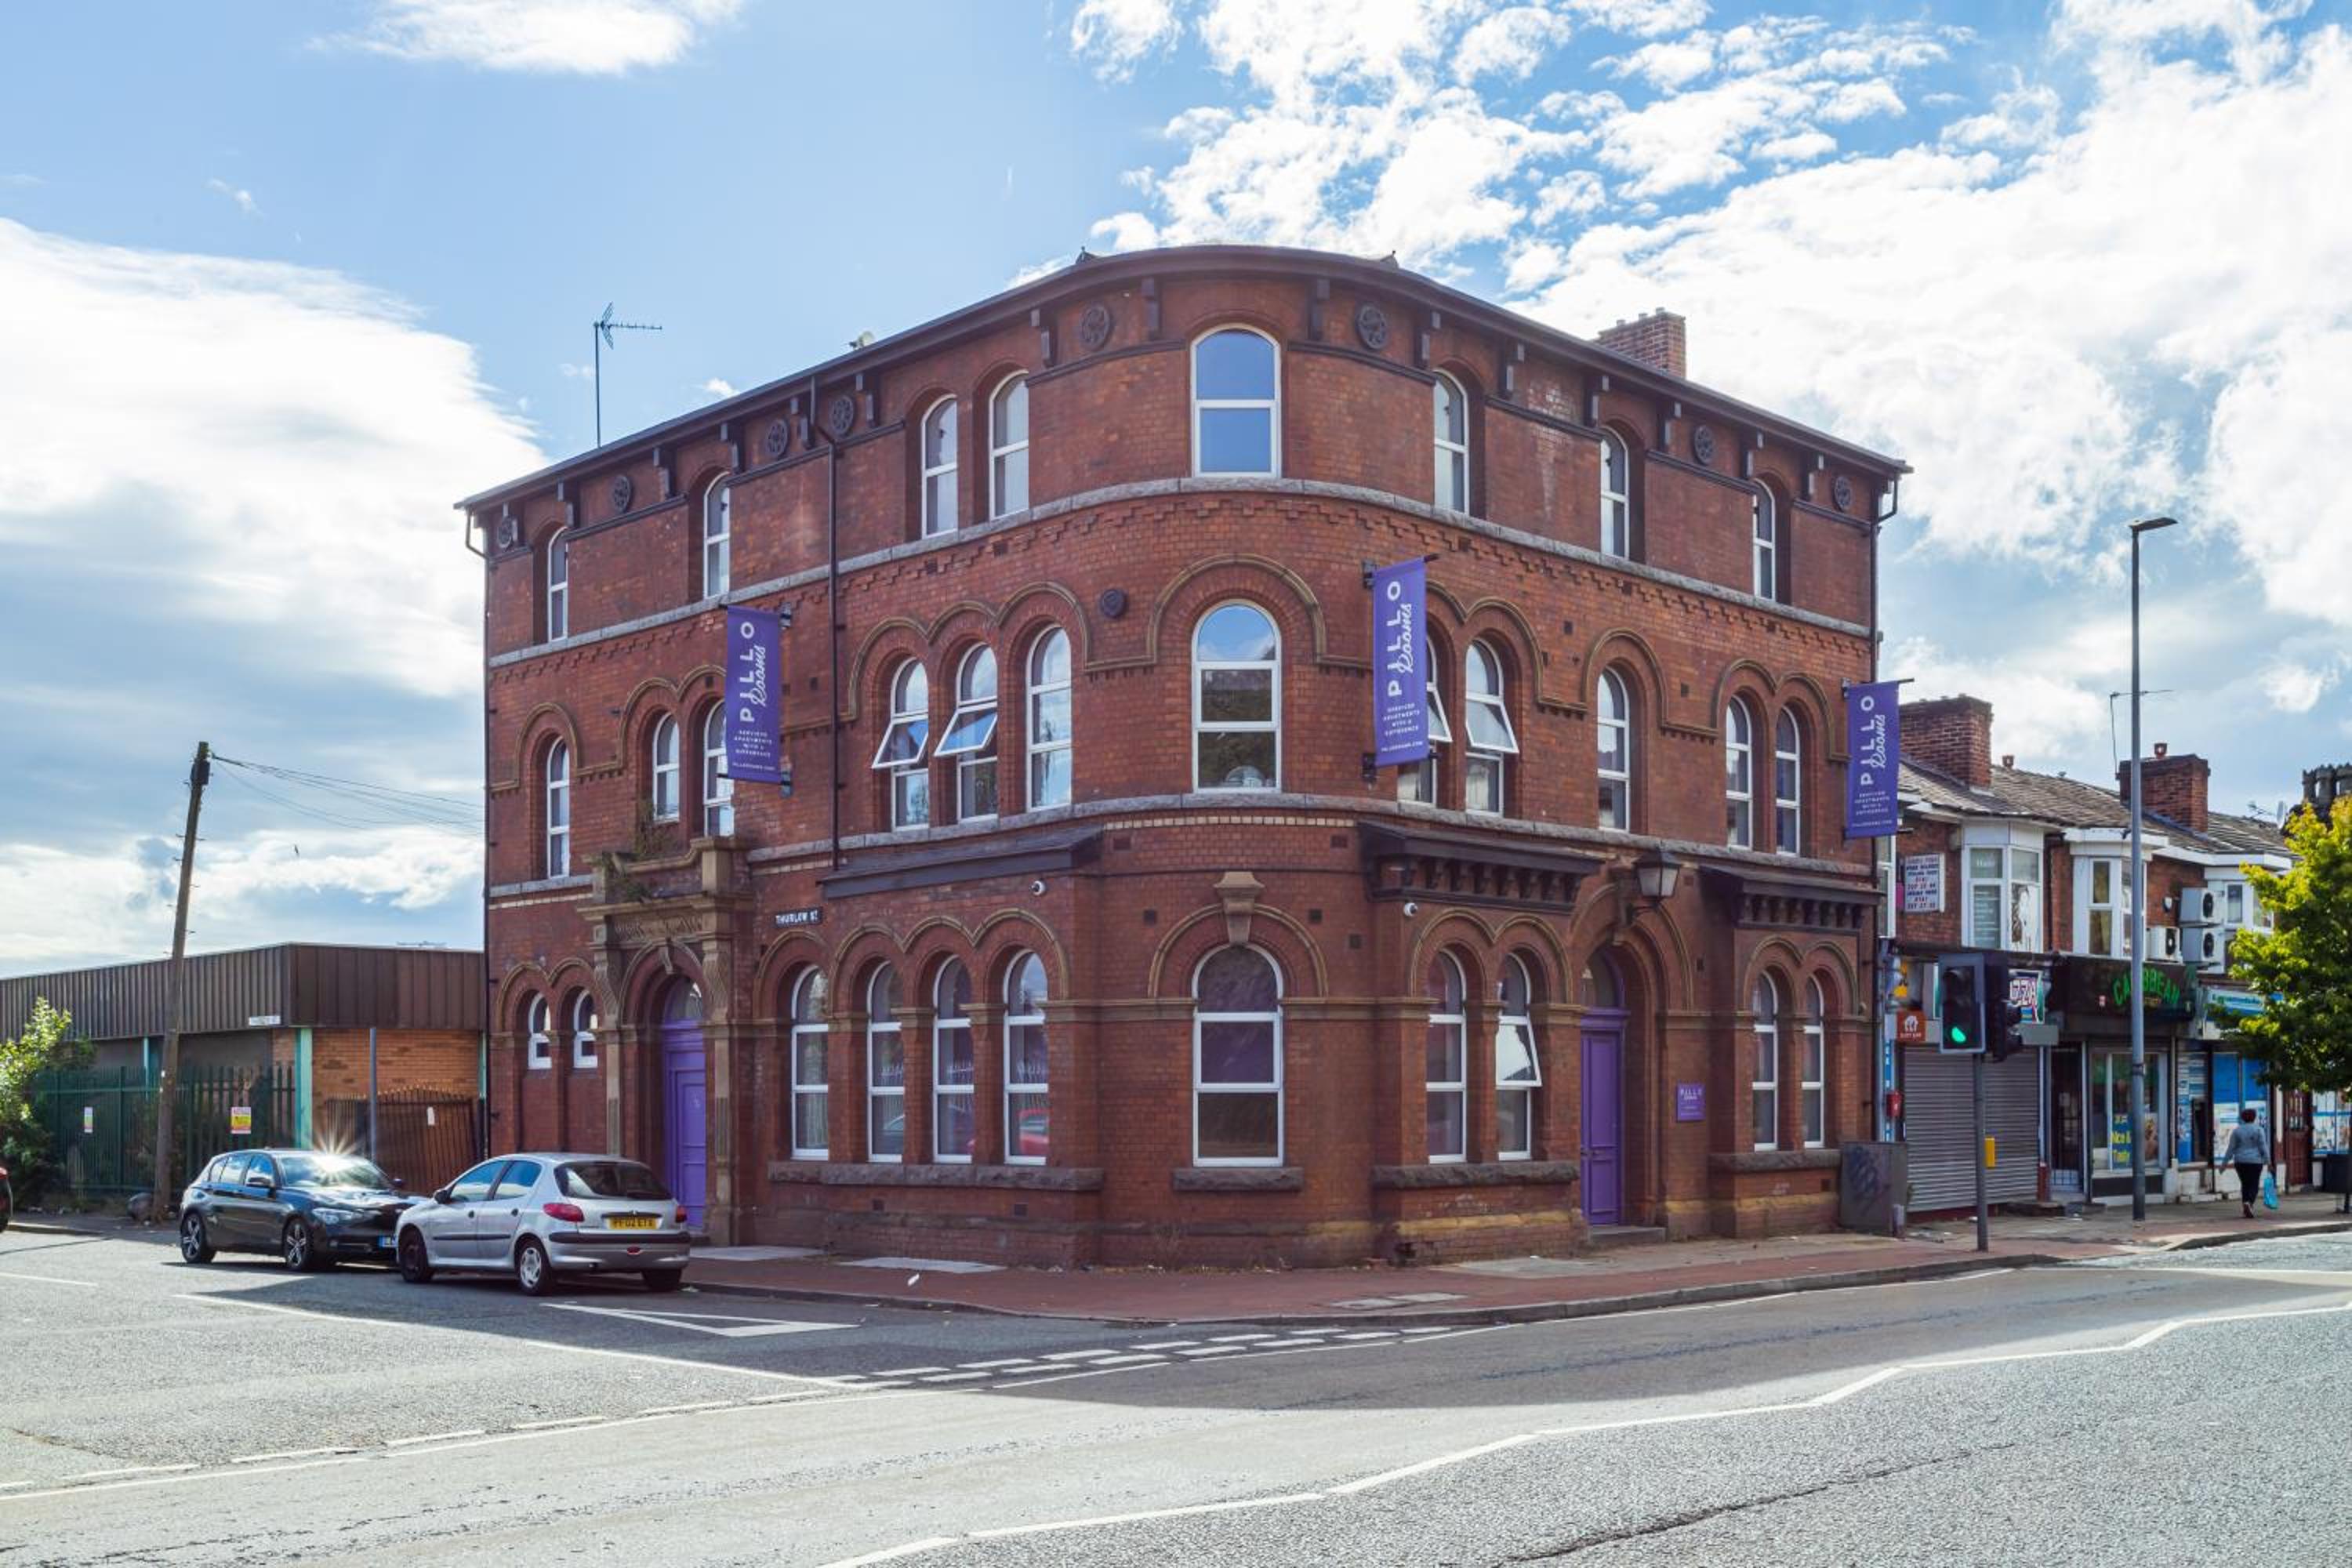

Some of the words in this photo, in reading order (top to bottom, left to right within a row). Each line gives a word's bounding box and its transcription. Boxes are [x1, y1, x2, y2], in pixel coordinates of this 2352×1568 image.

[739, 622, 755, 722] PILLO
[1387, 581, 1403, 697] PILLO
[1397, 602, 1414, 673] Rooms
[750, 644, 767, 707] Rooms
[1860, 695, 1875, 786] PILLO
[1869, 714, 1887, 768] Rooms
[2113, 968, 2180, 1006] CABBEAN
